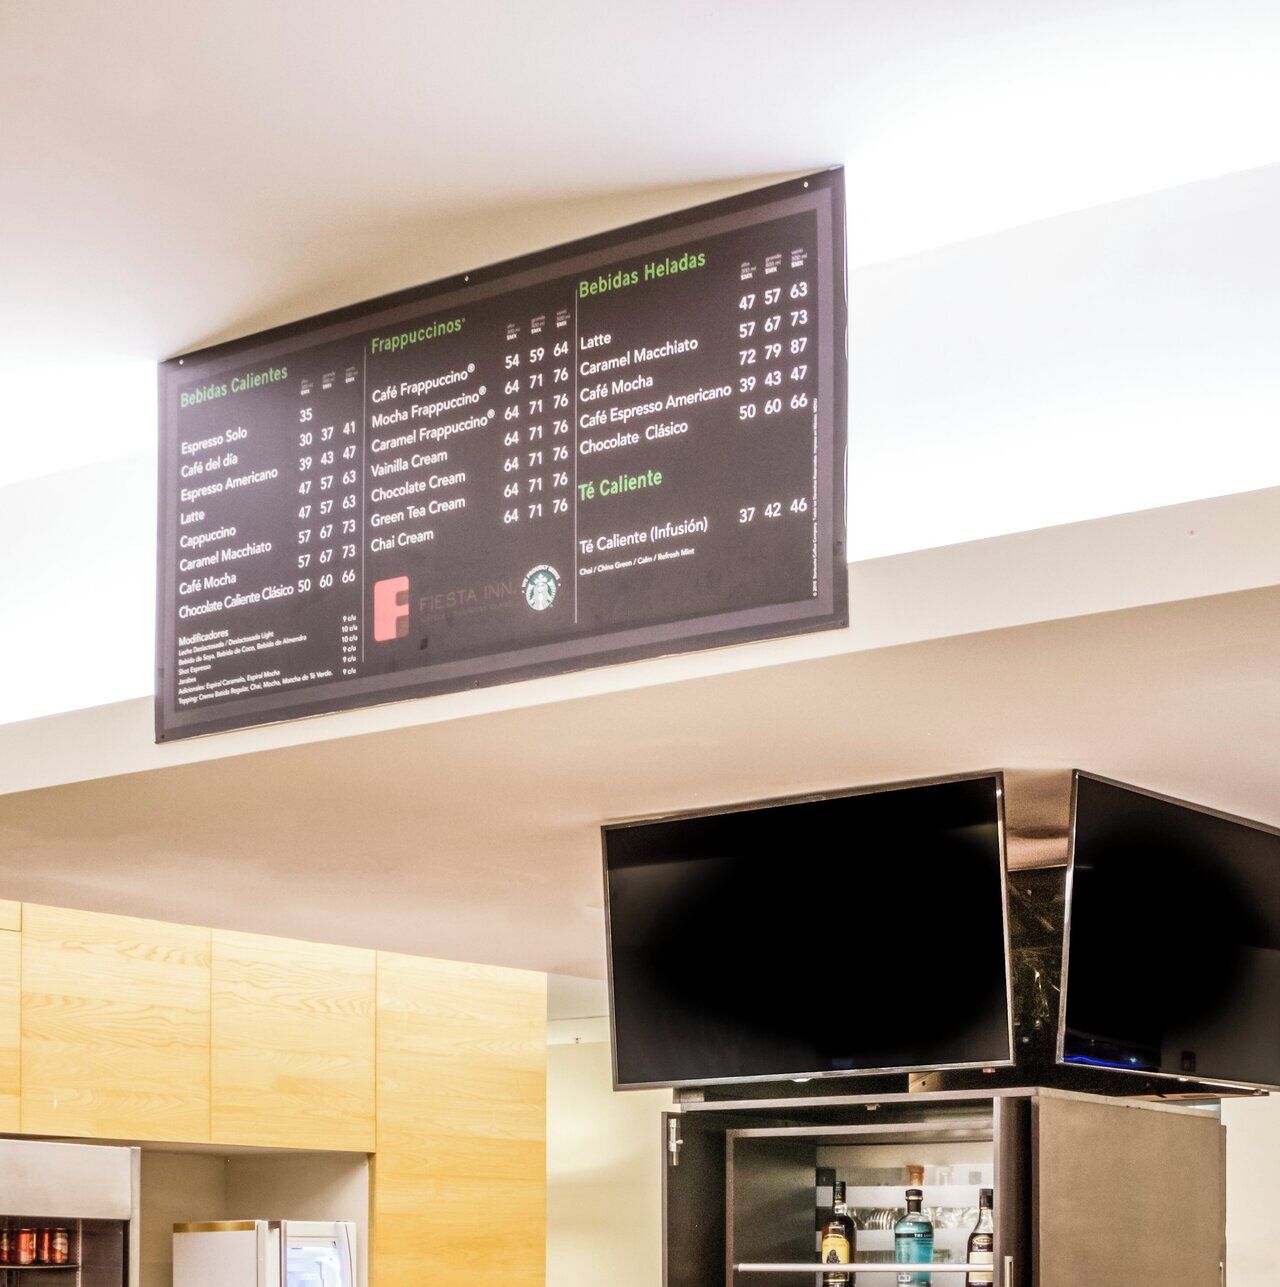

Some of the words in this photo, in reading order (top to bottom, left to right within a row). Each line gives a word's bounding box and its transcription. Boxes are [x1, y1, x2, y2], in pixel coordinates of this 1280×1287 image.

[579, 270, 639, 298] Bebidas
[644, 253, 706, 281] Heladas
[580, 333, 612, 350] Latte
[739, 293, 756, 310] 47
[764, 287, 781, 305] 57
[790, 281, 808, 299] 63
[580, 350, 630, 376] Caramel
[634, 339, 698, 363] Macchiato
[739, 321, 756, 338] 57
[764, 315, 781, 333] 67
[790, 309, 808, 327] 73
[181, 384, 227, 407] Bebidas
[231, 367, 288, 392] Calientes
[372, 385, 398, 403] Café
[505, 353, 520, 369] 54
[529, 347, 545, 363] 59
[553, 341, 569, 357] 64
[372, 409, 408, 428] Mocha
[504, 379, 520, 395] 64
[529, 373, 543, 389] 71
[553, 367, 569, 383] 76
[579, 383, 608, 402] Café
[612, 374, 653, 395] Mocha
[739, 348, 756, 366] 72
[764, 343, 782, 360] 79
[790, 337, 807, 354] 87
[580, 410, 607, 429] Café
[610, 401, 663, 424] Espresso
[665, 385, 732, 410] Americano
[739, 376, 756, 393] 39
[764, 370, 782, 387] 43
[790, 364, 808, 381] 47
[181, 461, 203, 477] Café
[205, 456, 221, 471] del
[223, 453, 238, 467] día
[299, 432, 313, 447] 30
[321, 426, 334, 441] 37
[343, 421, 355, 435] 41
[182, 435, 224, 456] Espresso
[226, 426, 248, 442] Solo
[300, 407, 313, 423] 35
[371, 429, 416, 453] Caramel
[504, 405, 520, 421] 64
[529, 399, 542, 415] 71
[553, 393, 569, 409] 76
[371, 458, 409, 477] Vainilla
[411, 451, 448, 468] Cream
[504, 431, 520, 446] 64
[529, 425, 542, 441] 71
[553, 419, 568, 435] 76
[579, 432, 640, 455] Chocolate
[645, 421, 688, 440] Clásico
[739, 403, 756, 420] 50
[764, 398, 782, 415] 60
[790, 393, 808, 409] 66
[181, 483, 223, 502] Espresso
[225, 468, 278, 490] Americano
[299, 456, 312, 471] 39
[320, 451, 334, 465] 43
[343, 445, 356, 459] 47
[181, 511, 205, 525] Latte
[298, 480, 312, 495] 47
[320, 475, 333, 490] 57
[342, 469, 356, 485] 63
[371, 481, 426, 502] Chocolate
[428, 472, 466, 489] Cream
[504, 456, 519, 472] 64
[529, 451, 542, 467] 71
[553, 445, 568, 461] 76
[371, 512, 404, 527] Green
[406, 505, 426, 519] Tea
[428, 498, 465, 514] Cream
[504, 482, 519, 498] 64
[529, 477, 542, 493] 71
[553, 471, 568, 487] 76
[578, 481, 595, 501] Té
[599, 469, 662, 496] Caliente
[180, 526, 236, 549] Cappuccino
[298, 505, 311, 519] 47
[320, 500, 333, 515] 57
[342, 494, 356, 509] 63
[180, 551, 219, 571] Caramel
[221, 542, 272, 562] Macchiato
[298, 529, 311, 544] 57
[319, 524, 333, 539] 67
[342, 519, 356, 534] 73
[371, 535, 395, 552] Chai
[397, 530, 434, 546] Cream
[504, 508, 519, 524] 64
[528, 503, 542, 519] 71
[553, 498, 568, 514] 76
[579, 539, 594, 554] Té
[596, 531, 647, 551] Caliente
[650, 516, 708, 543] (Infusión)
[739, 507, 756, 524] 37
[764, 502, 781, 518] 42
[790, 497, 807, 513] 46
[179, 579, 202, 595] Café
[204, 572, 237, 589] Mocha
[298, 554, 311, 568] 57
[319, 549, 333, 564] 67
[342, 544, 356, 559] 73
[179, 600, 223, 619] Chocolate
[223, 592, 261, 609] Caliente
[261, 584, 294, 600] Clásico
[298, 578, 311, 593] 50
[319, 574, 333, 588] 60
[341, 569, 356, 584] 66
[420, 588, 477, 611] FIESTA
[179, 629, 229, 646] Modificadores
